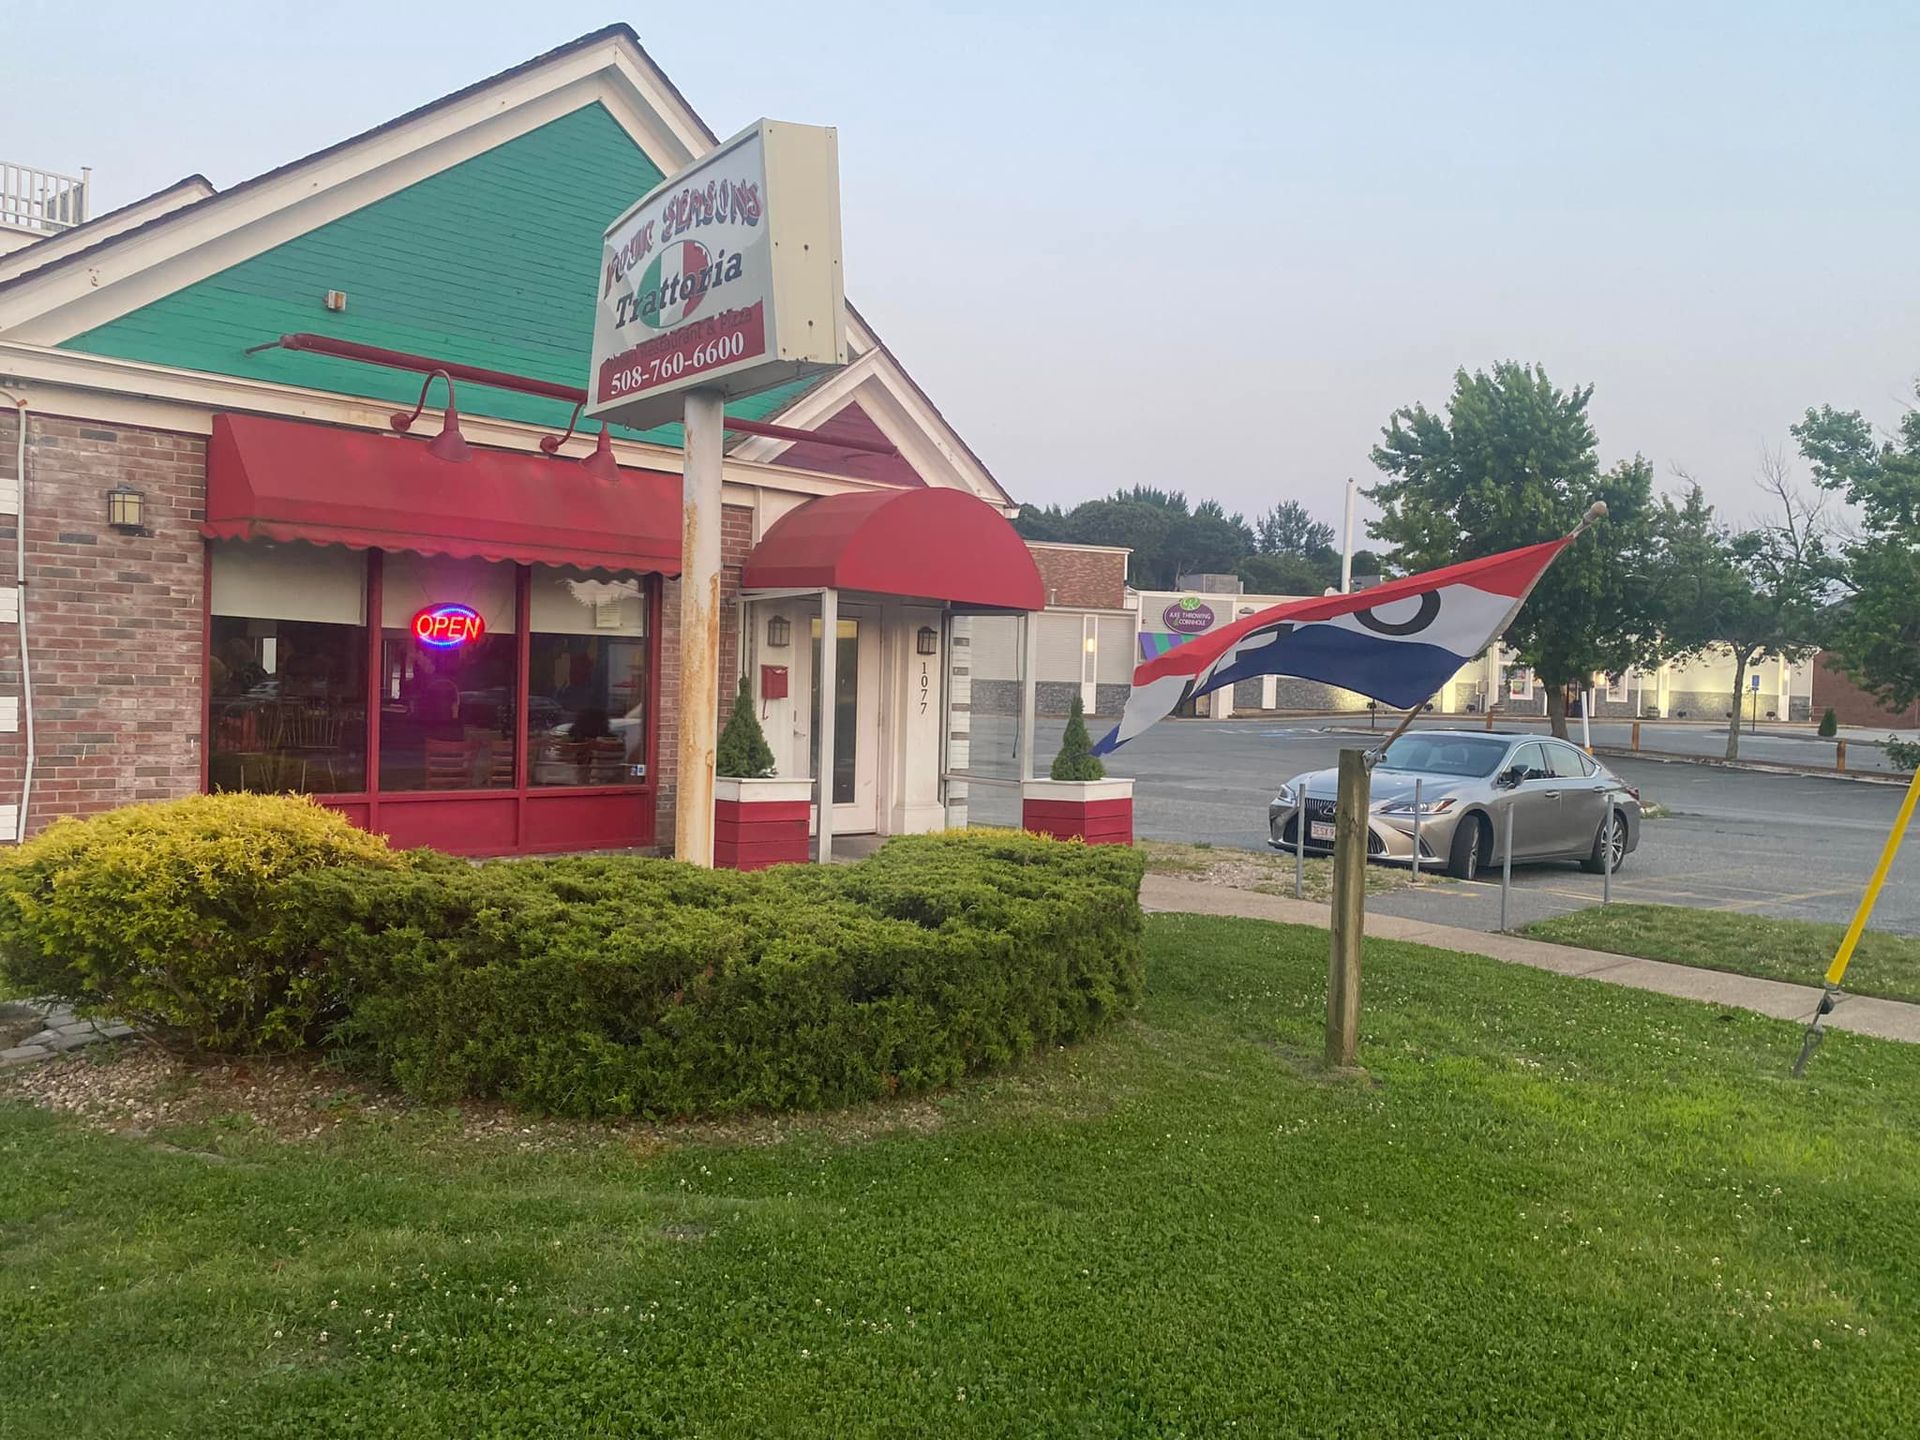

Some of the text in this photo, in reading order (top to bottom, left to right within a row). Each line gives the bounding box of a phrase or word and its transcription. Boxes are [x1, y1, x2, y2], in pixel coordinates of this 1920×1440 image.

[661, 179, 762, 243] SEASONS
[615, 249, 743, 330] Trattoria
[610, 331, 744, 395] 508-760-6600
[417, 614, 481, 639] OPEN
[1183, 612, 1211, 620] THROWING
[920, 661, 929, 715] 1077
